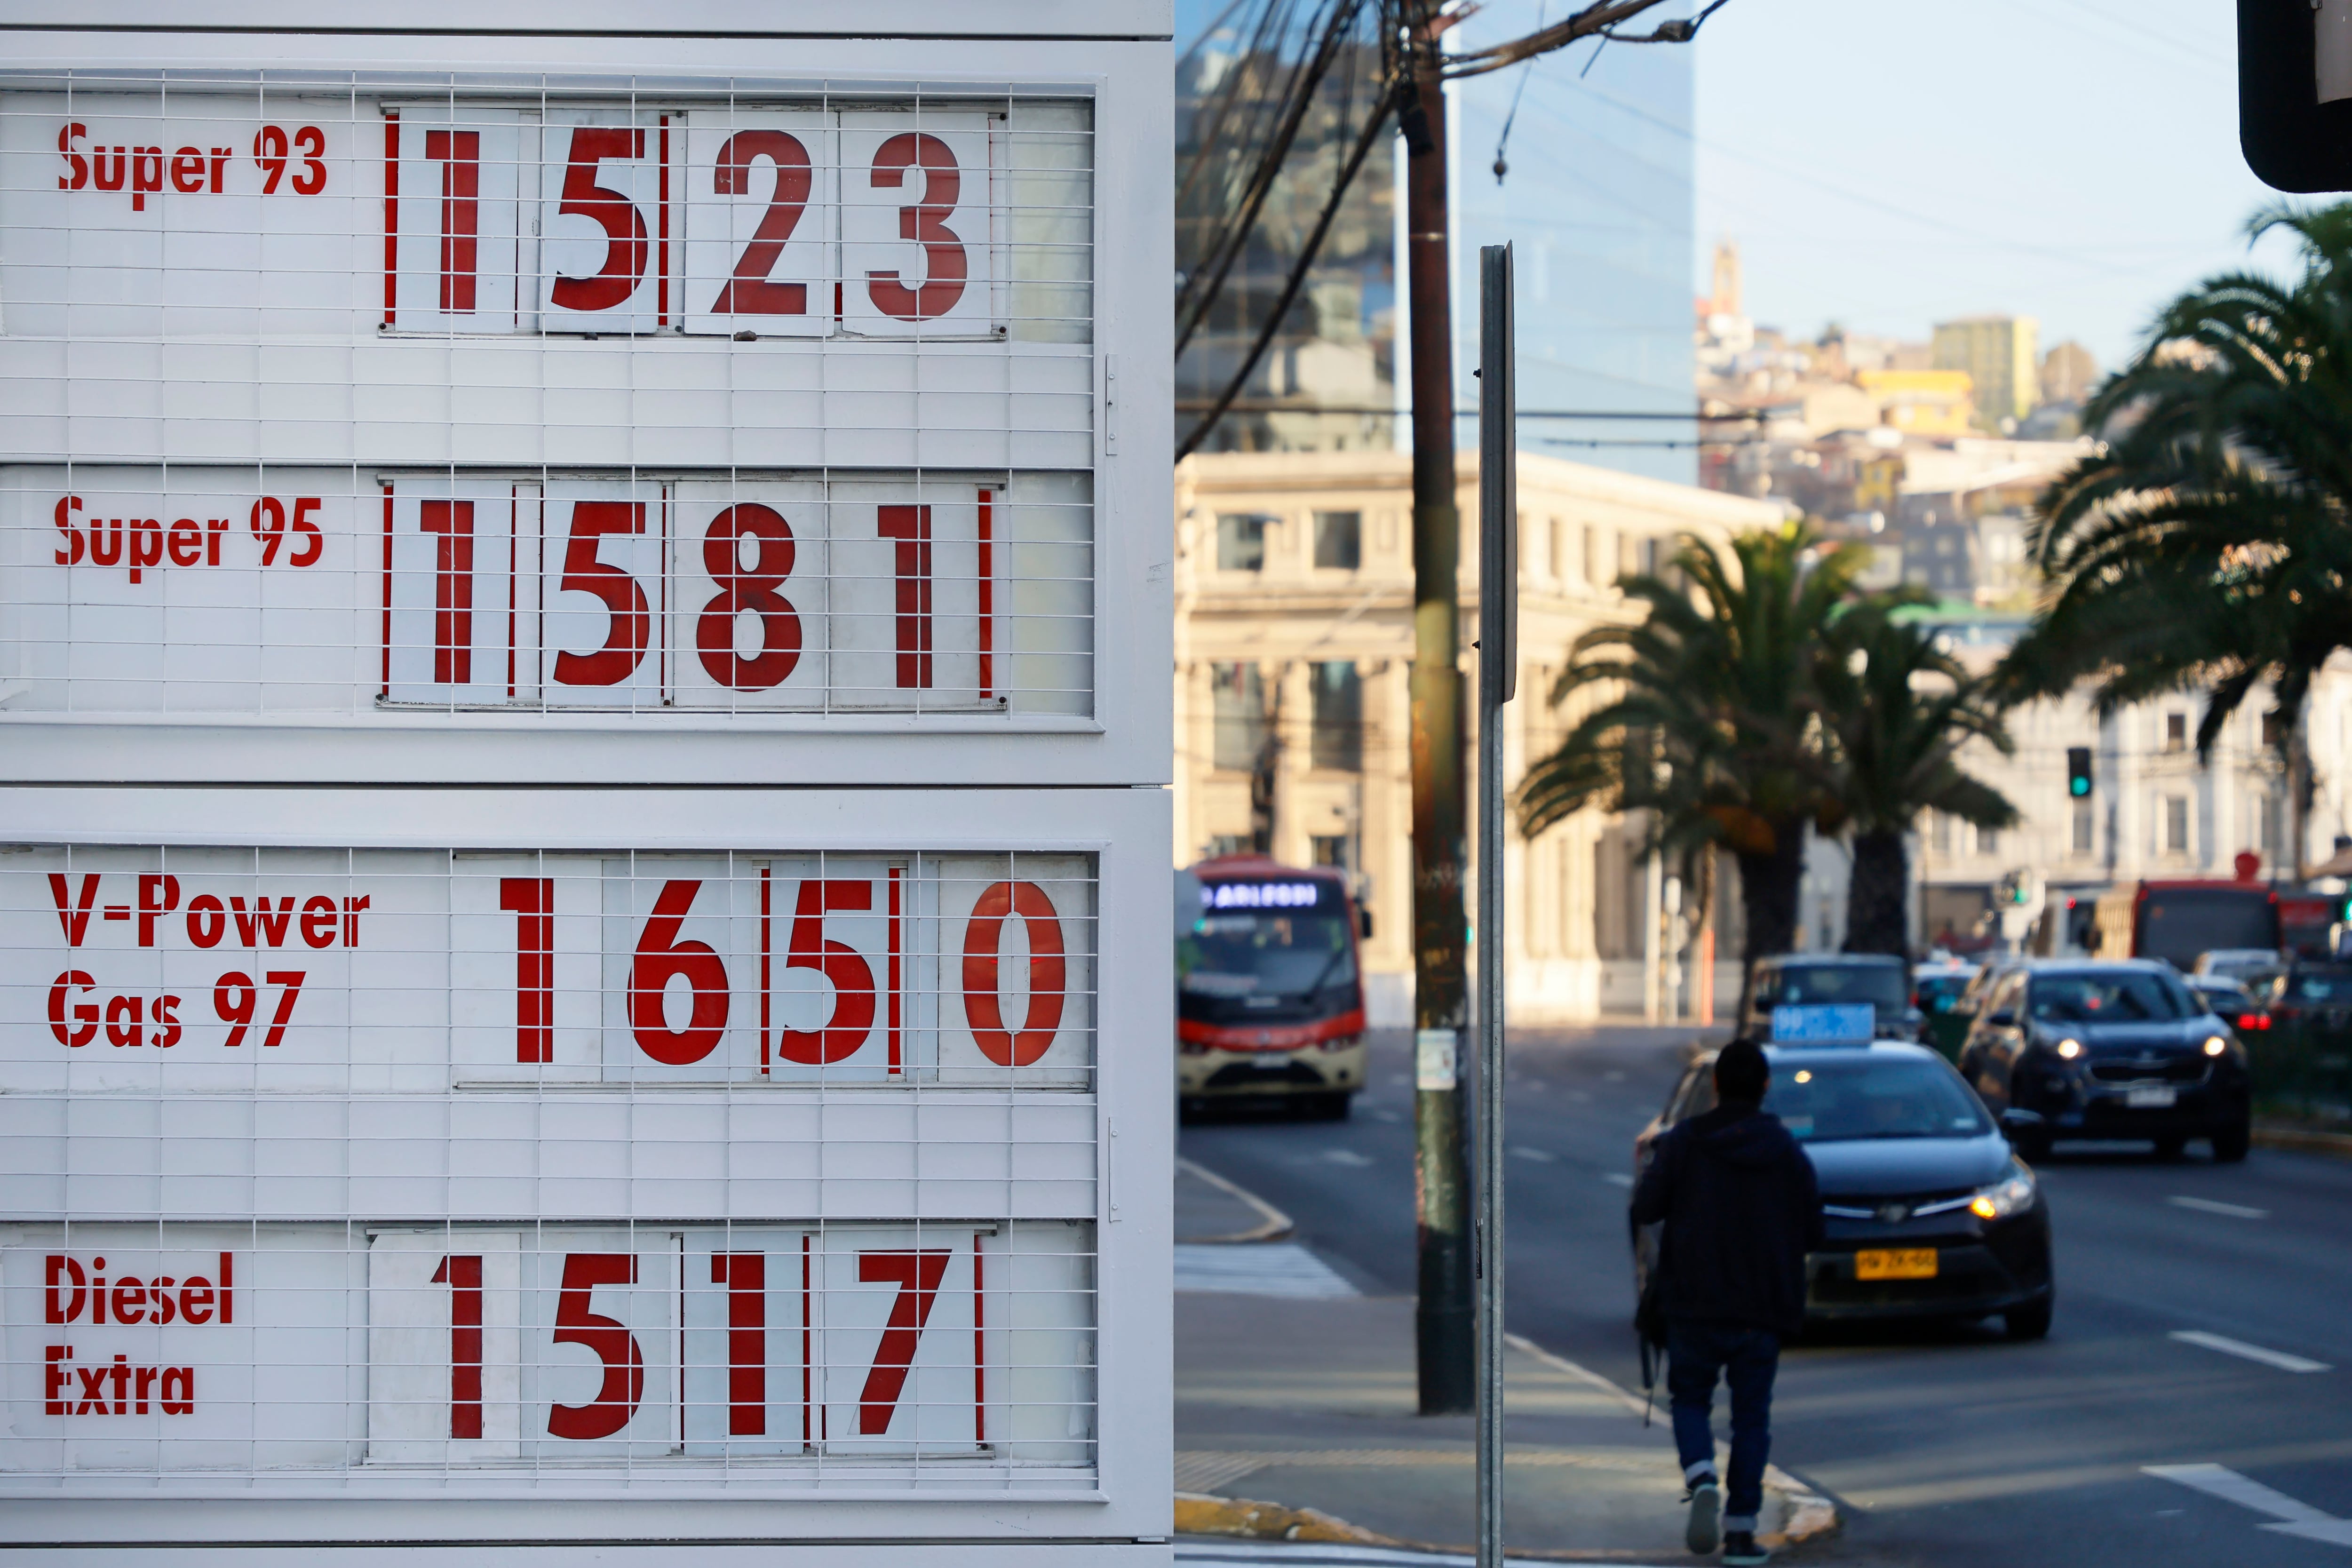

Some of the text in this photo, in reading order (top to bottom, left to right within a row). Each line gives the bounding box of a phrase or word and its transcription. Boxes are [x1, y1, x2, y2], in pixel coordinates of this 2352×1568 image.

[58, 122, 327, 211] Super 93
[425, 127, 968, 322] 1523
[54, 495, 324, 584] Super 95
[421, 500, 932, 692] 1581
[48, 872, 371, 949] V-Power
[48, 970, 307, 1048] Gas 97
[500, 878, 1066, 1067] 1650
[45, 1251, 233, 1325] Diesel
[45, 1345, 194, 1416] Extra
[430, 1249, 953, 1440] 1517
